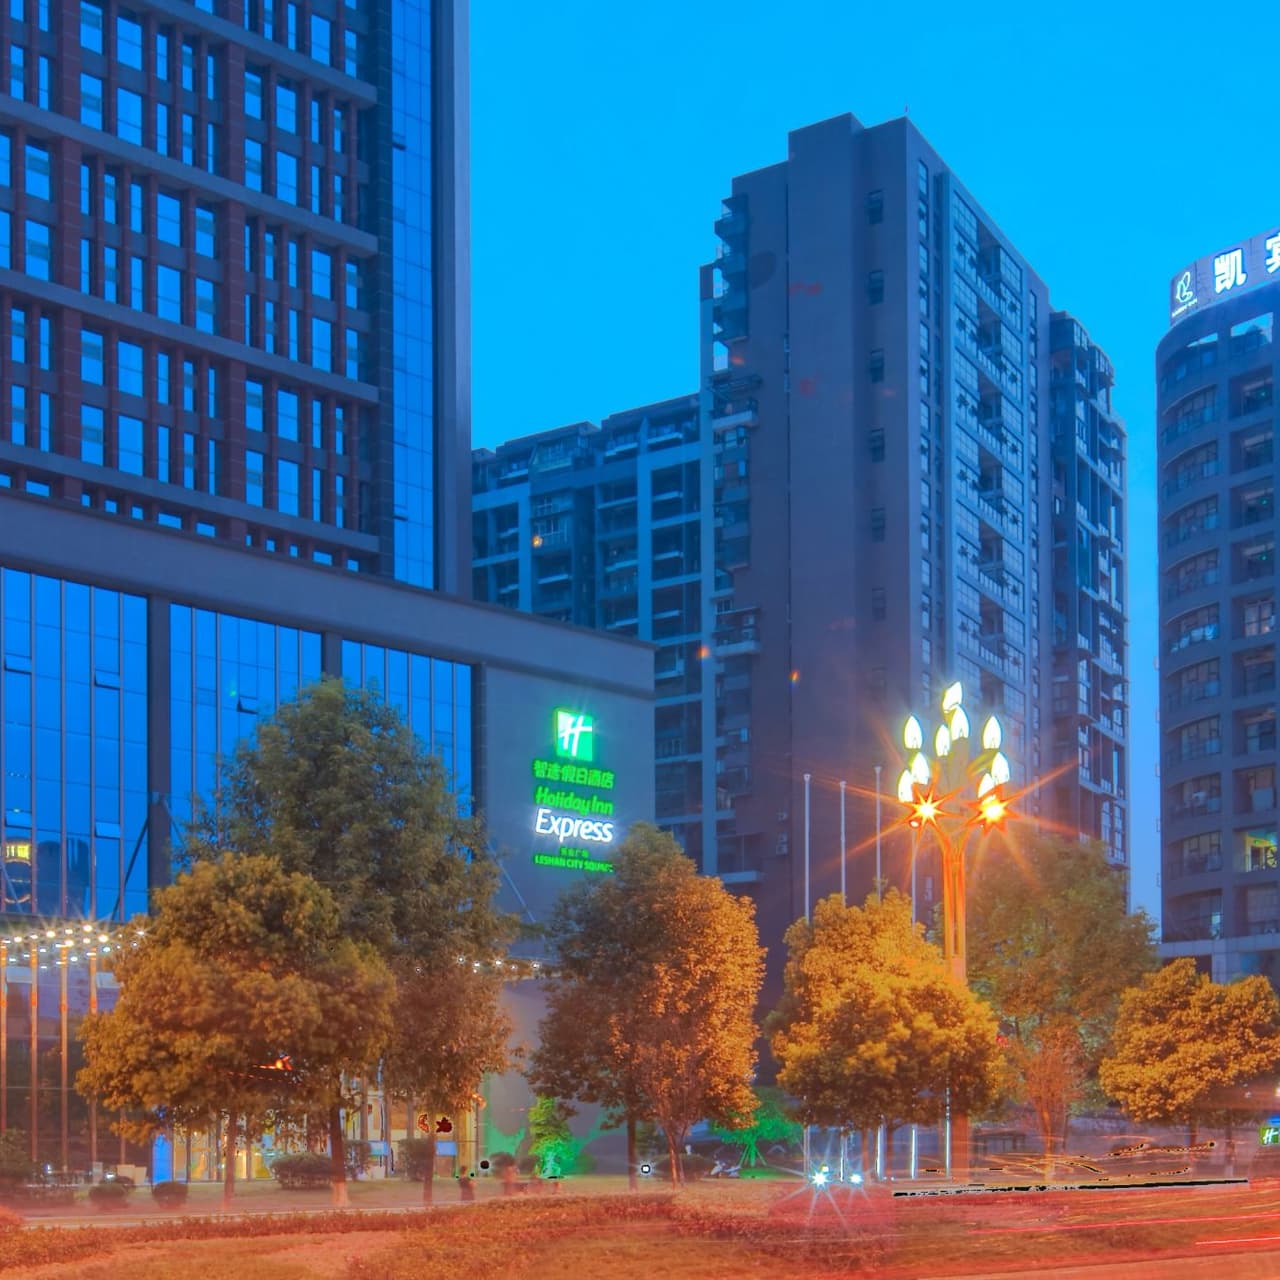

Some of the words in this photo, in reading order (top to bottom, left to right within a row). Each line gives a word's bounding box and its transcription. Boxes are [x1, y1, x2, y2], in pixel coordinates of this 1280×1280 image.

[535, 785, 591, 816] Holiday
[591, 795, 613, 815] Inn
[536, 808, 615, 843] Express
